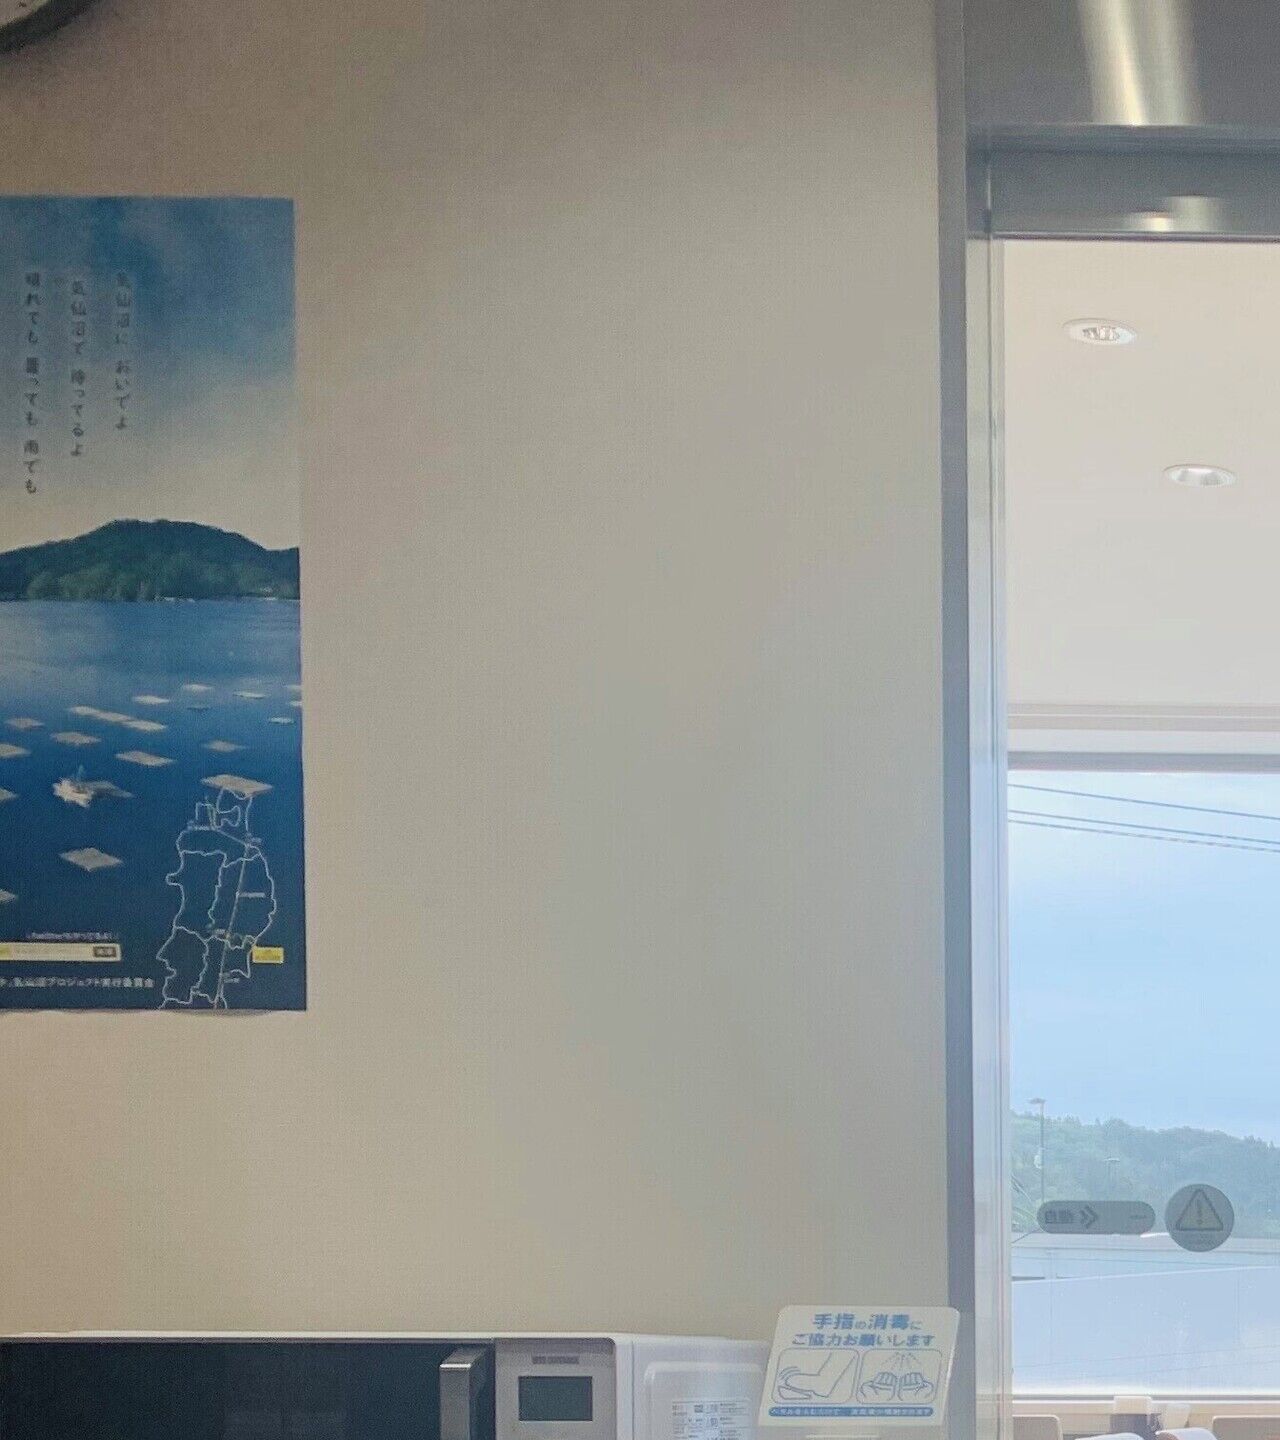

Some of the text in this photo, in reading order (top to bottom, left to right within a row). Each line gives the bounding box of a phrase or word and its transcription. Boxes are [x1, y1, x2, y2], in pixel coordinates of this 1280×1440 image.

[812, 1313, 922, 1331] 手指の消毒に
[792, 1333, 935, 1347] ご協力お願いします
